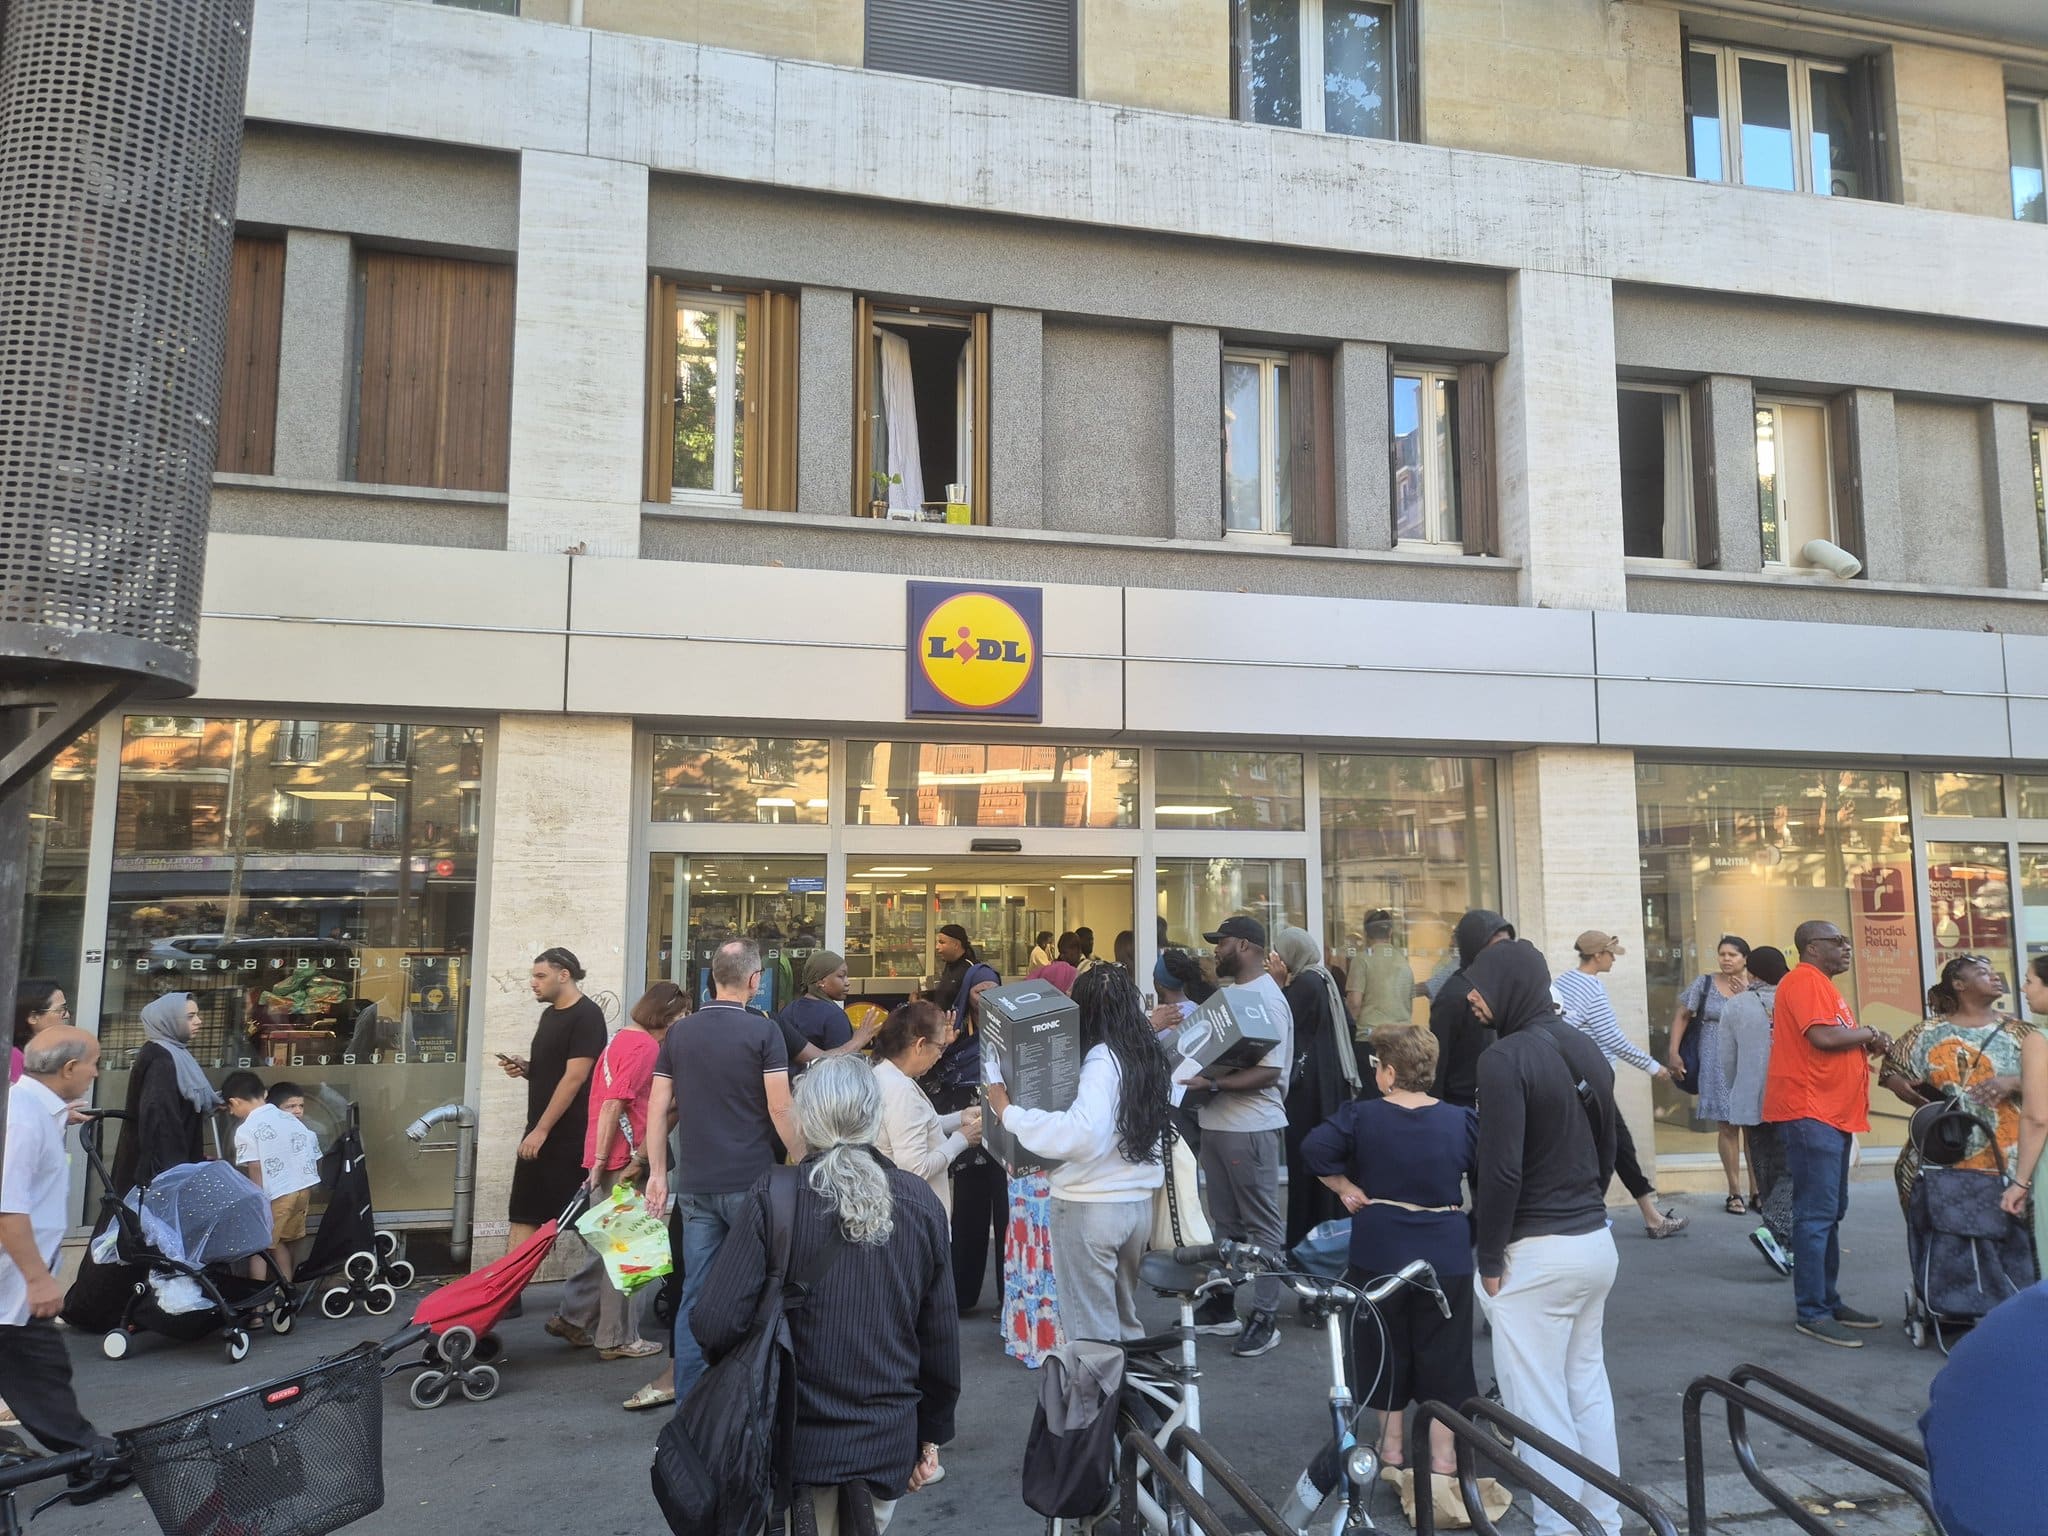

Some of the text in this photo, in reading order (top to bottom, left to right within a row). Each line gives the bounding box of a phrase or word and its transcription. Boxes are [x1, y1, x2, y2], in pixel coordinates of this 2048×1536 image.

[928, 626, 1026, 665] LIDL
[1864, 925, 1907, 936] Mondial
[1865, 936, 1898, 950] Relay
[1032, 1019, 1060, 1033] TRONIC
